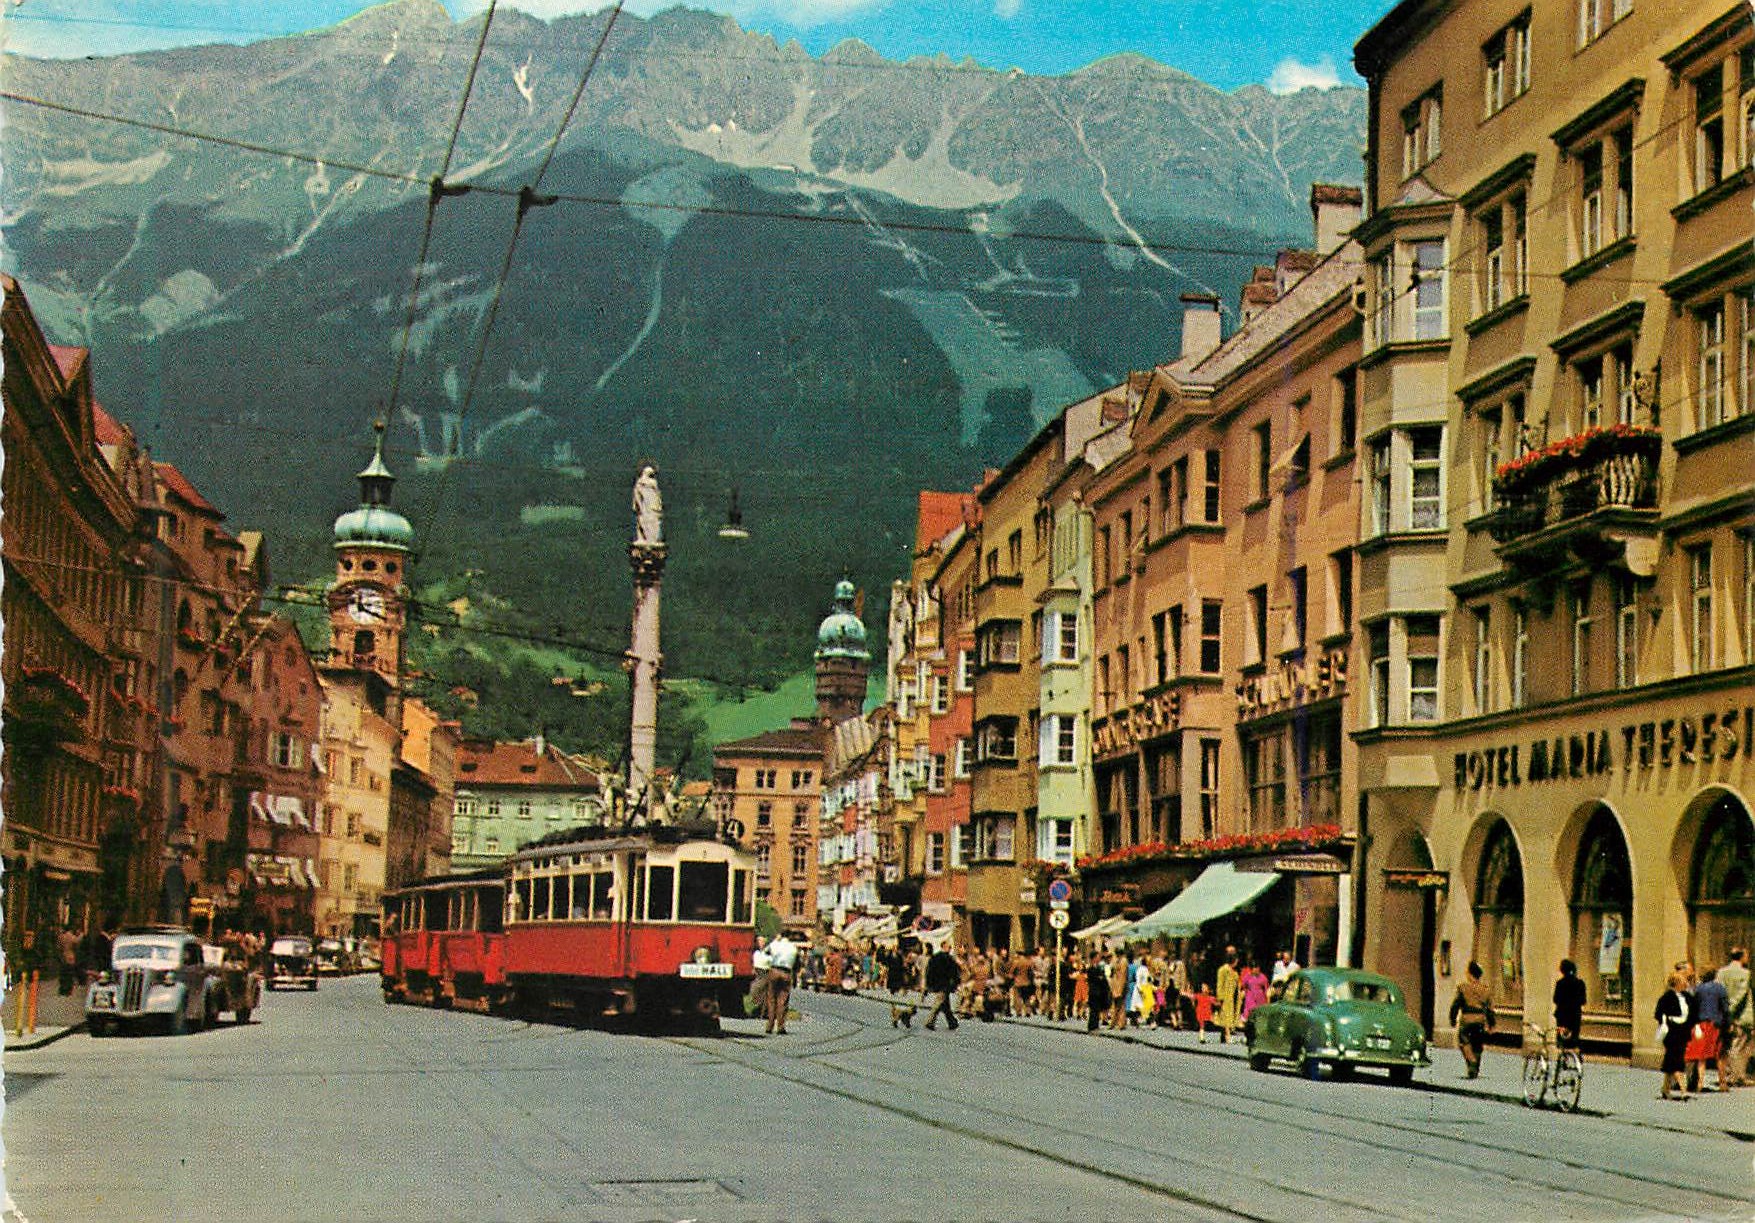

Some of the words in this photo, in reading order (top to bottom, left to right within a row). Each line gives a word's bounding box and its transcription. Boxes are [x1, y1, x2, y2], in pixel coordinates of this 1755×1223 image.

[1455, 744, 1521, 791] HOTEL
[1528, 729, 1613, 782] MARIA
[1620, 706, 1754, 772] THERESI
[727, 820, 739, 840] 4
[701, 965, 729, 976] HALL
